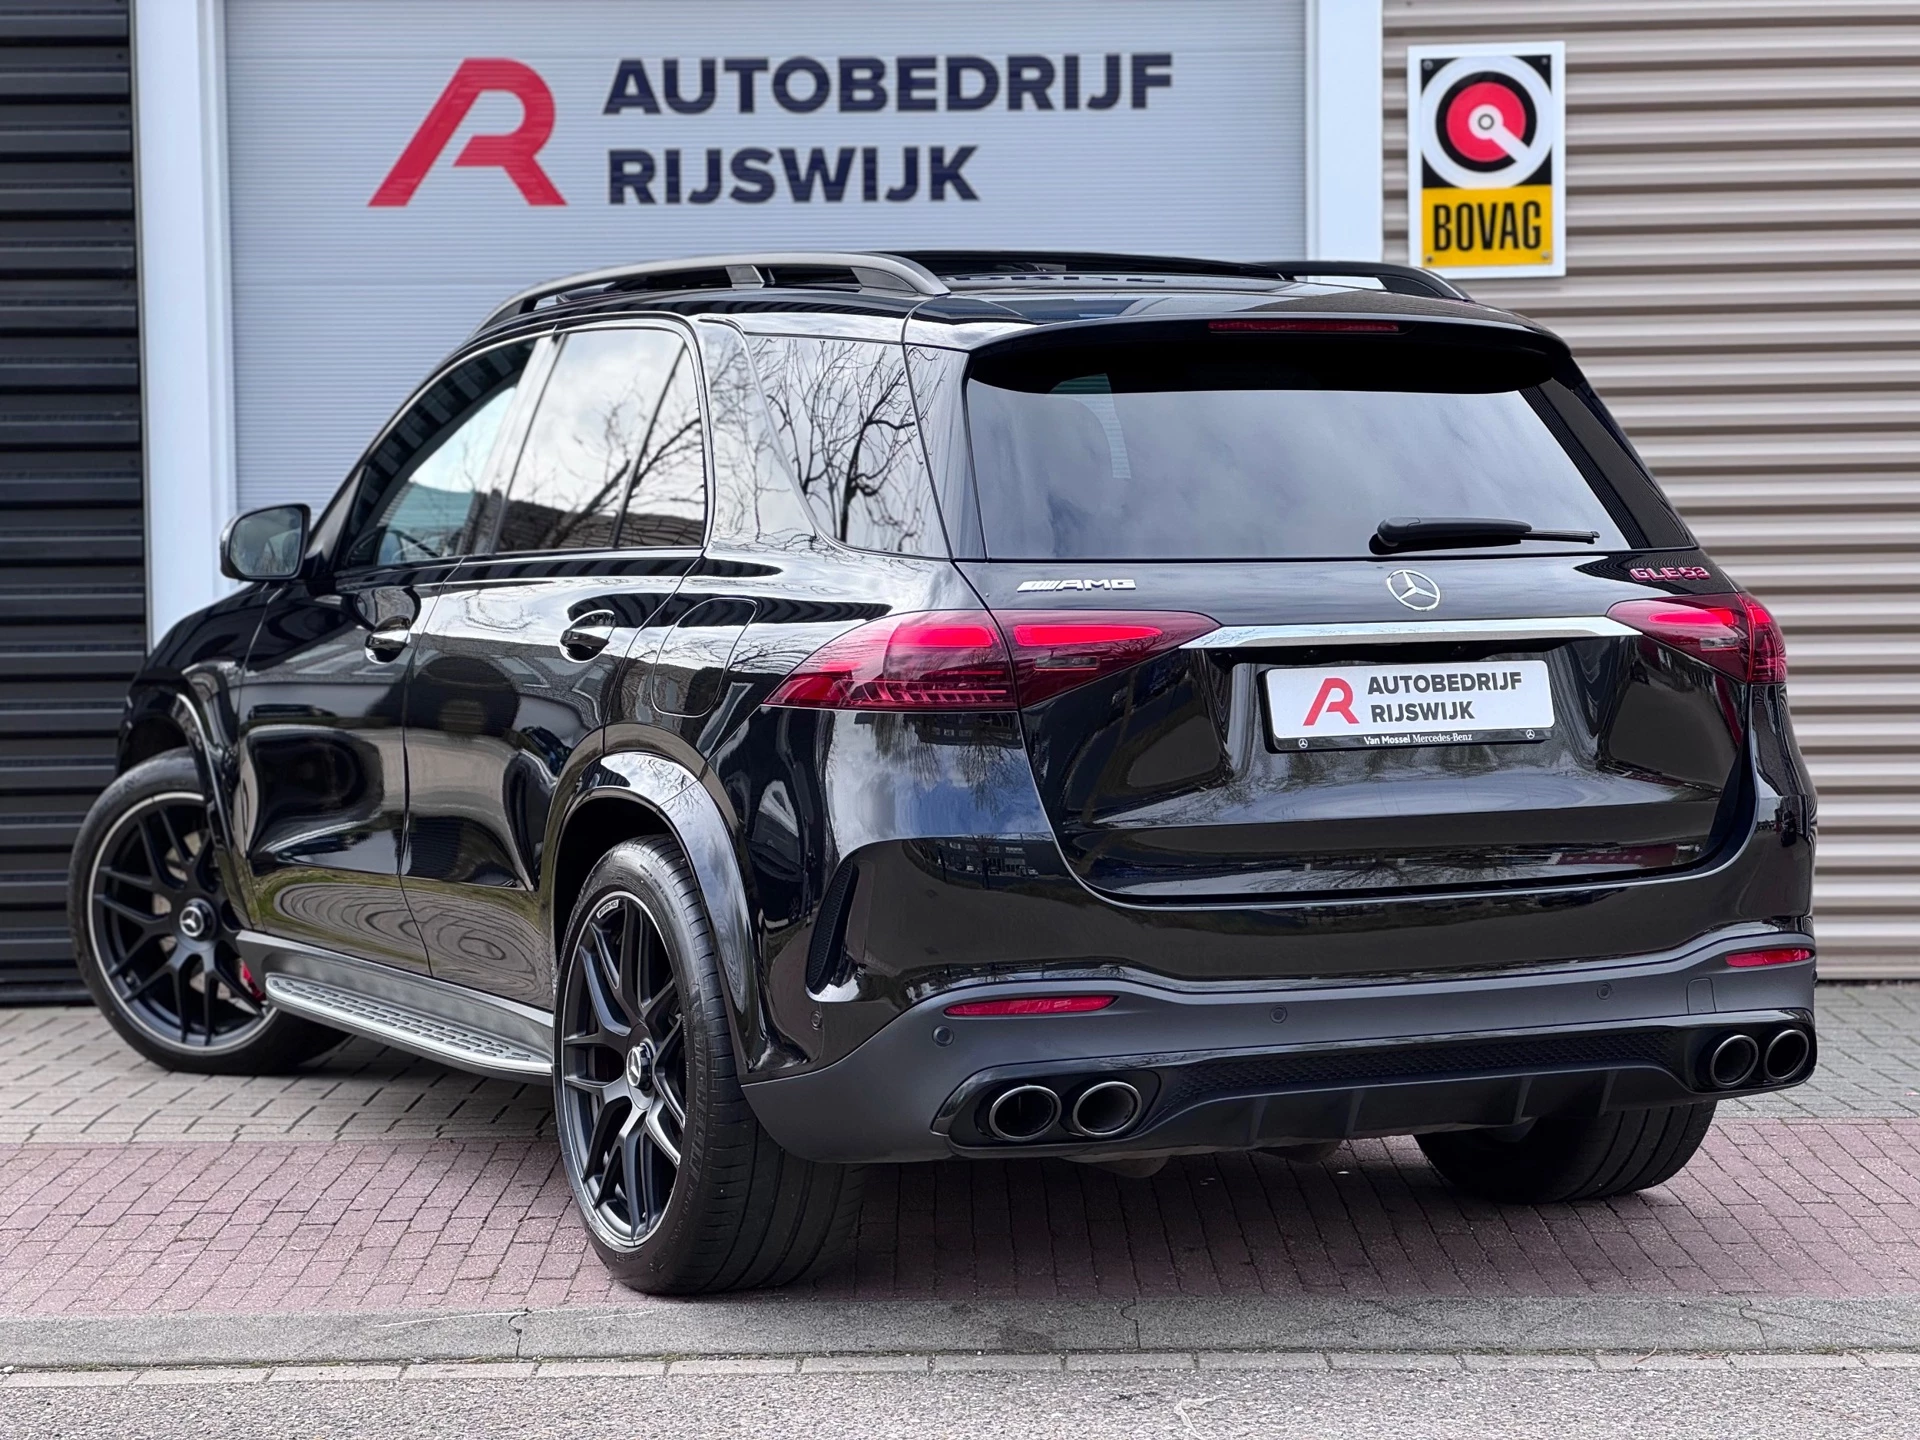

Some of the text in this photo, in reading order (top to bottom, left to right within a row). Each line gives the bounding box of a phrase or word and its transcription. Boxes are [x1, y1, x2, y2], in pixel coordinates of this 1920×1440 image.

[603, 53, 1173, 115] AUTOBEDRIJF
[608, 146, 980, 205] RIJSWIJK
[1433, 200, 1541, 252] BOVAG
[1055, 579, 1136, 591] AMG
[1367, 671, 1522, 695] AUTOBEDRIJF
[1371, 701, 1475, 723] RIJSWIJK
[1364, 732, 1473, 745] Van Mossel Mercedes-Benz
